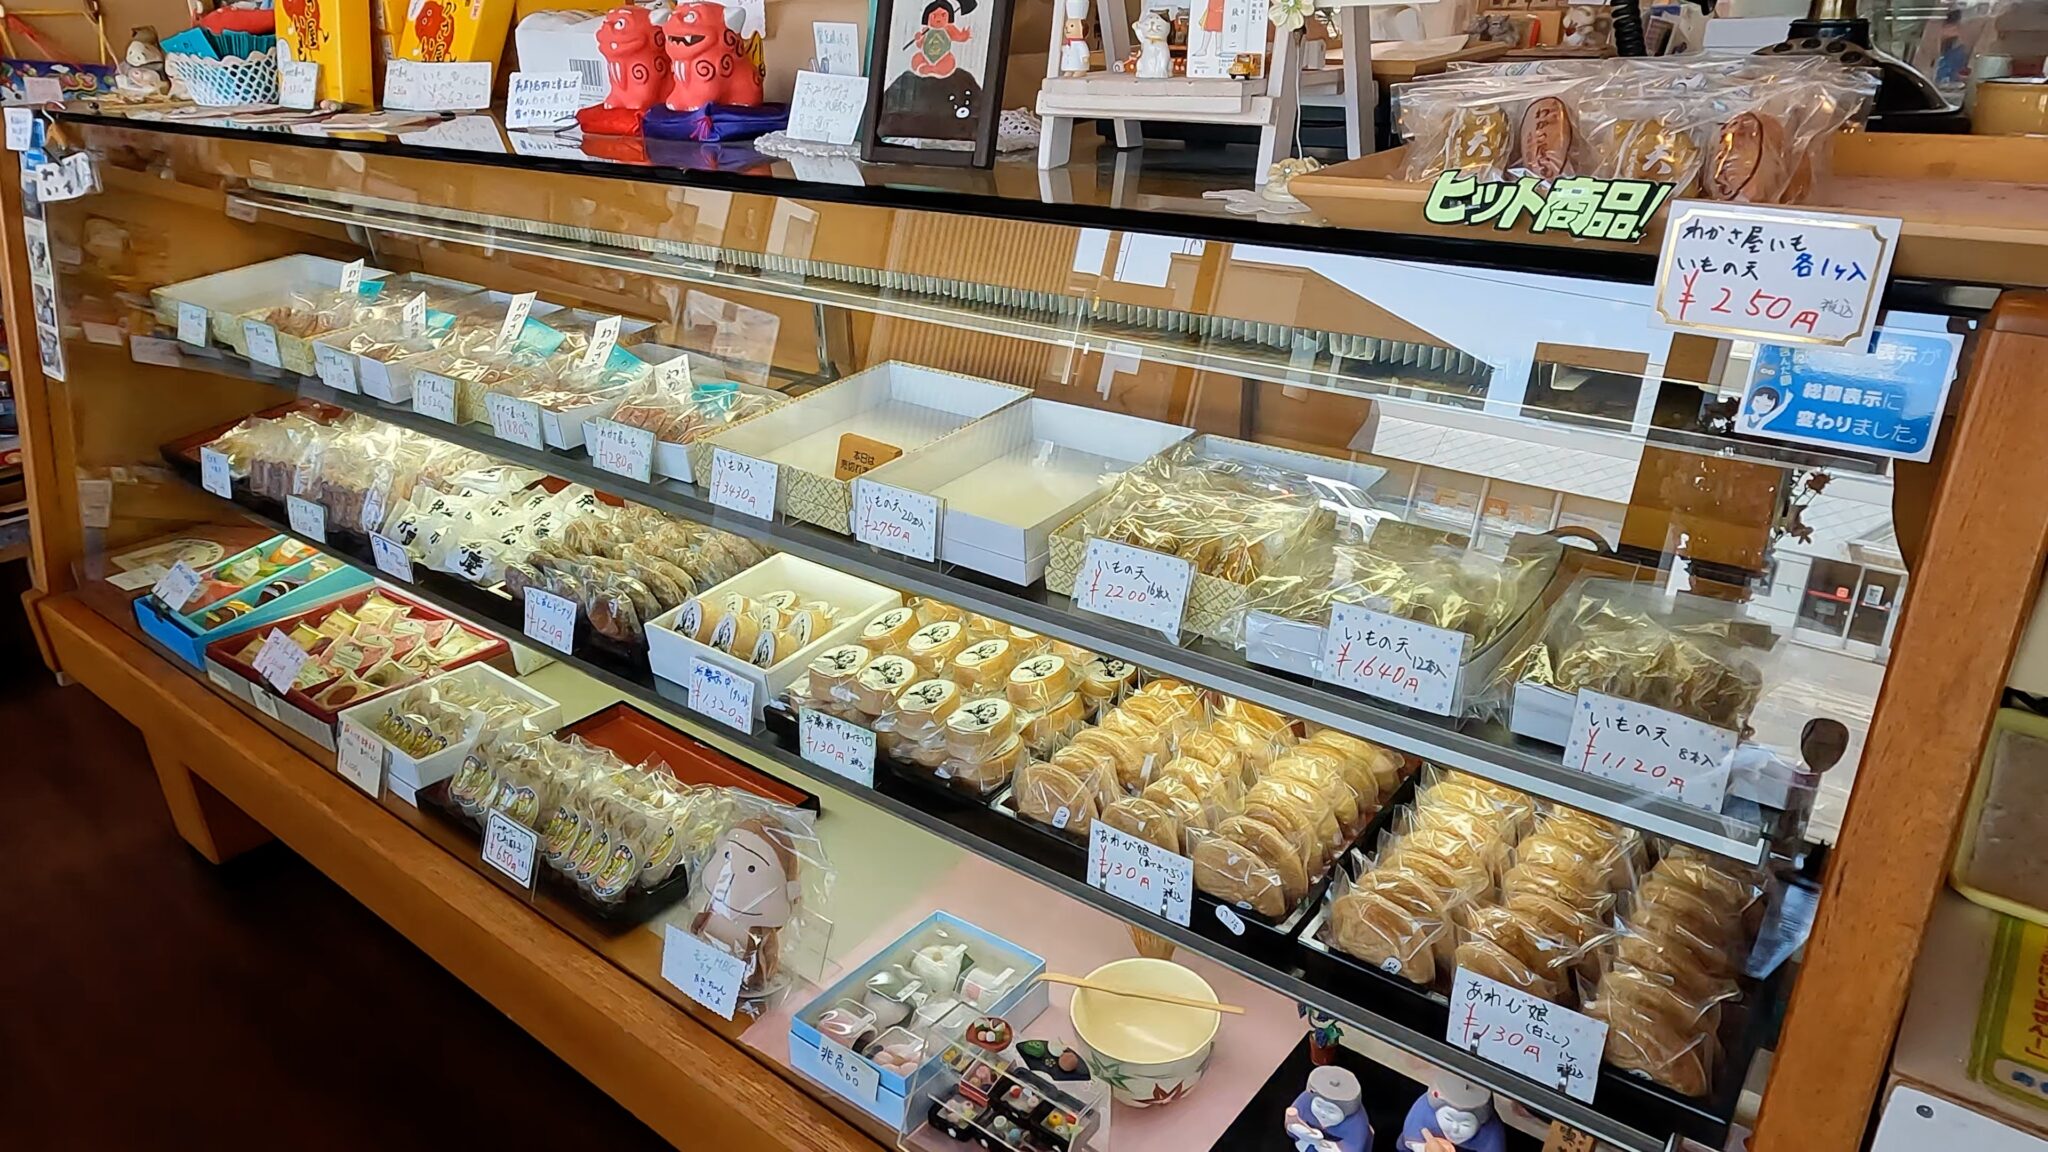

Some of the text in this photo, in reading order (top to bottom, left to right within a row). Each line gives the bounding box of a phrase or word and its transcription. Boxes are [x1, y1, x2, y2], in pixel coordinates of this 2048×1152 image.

[1424, 169, 1673, 241] ヒット商品!
[1682, 218, 1807, 253] わかさ屋いも
[1677, 255, 1759, 281] いもの天
[1820, 297, 1854, 319] 税込
[1801, 381, 1904, 412] 総額表示に
[1794, 409, 1918, 446] 変わりました。
[1097, 560, 1151, 583] いもの天
[1344, 626, 1413, 661] いもの天
[1589, 711, 1670, 748] いもの天
[1465, 980, 1550, 1026] あわび娘
[821, 1045, 860, 1088] 非売品
